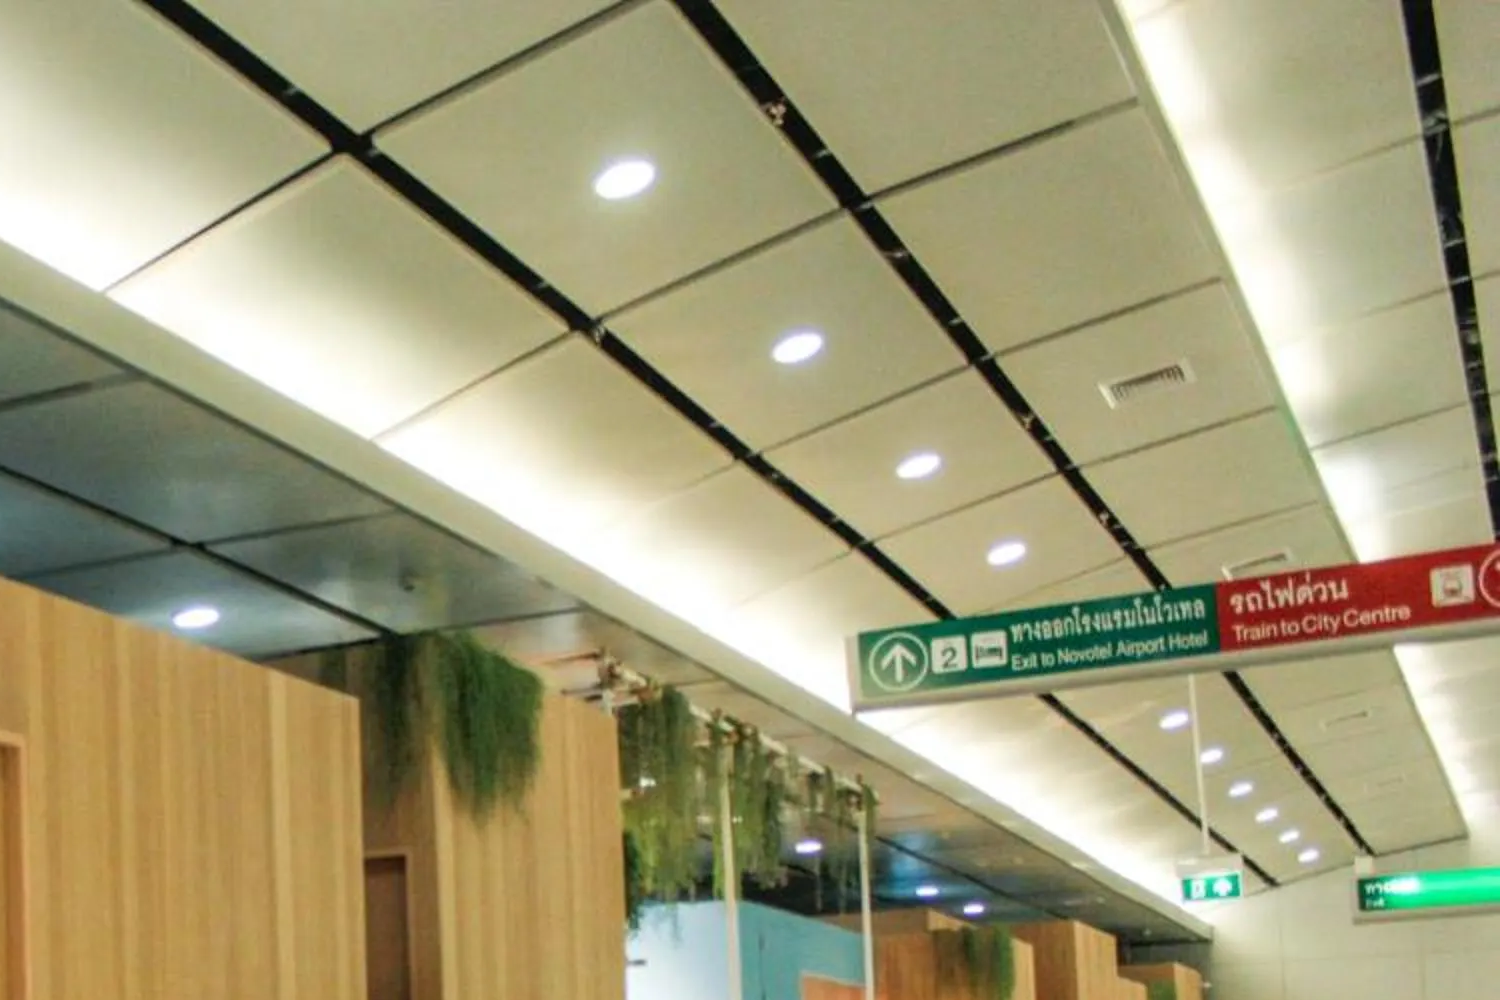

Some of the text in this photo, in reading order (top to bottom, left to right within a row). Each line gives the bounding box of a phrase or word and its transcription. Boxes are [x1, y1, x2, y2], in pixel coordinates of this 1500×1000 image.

[1230, 571, 1348, 614] รถไฟด่วน
[1010, 595, 1205, 642] ทางออกโรงแรมโนโวเทล
[1232, 604, 1411, 642] Train to City Centre
[941, 646, 958, 668] 2
[1011, 630, 1208, 671] Exit to Novotel Airport Hotel
